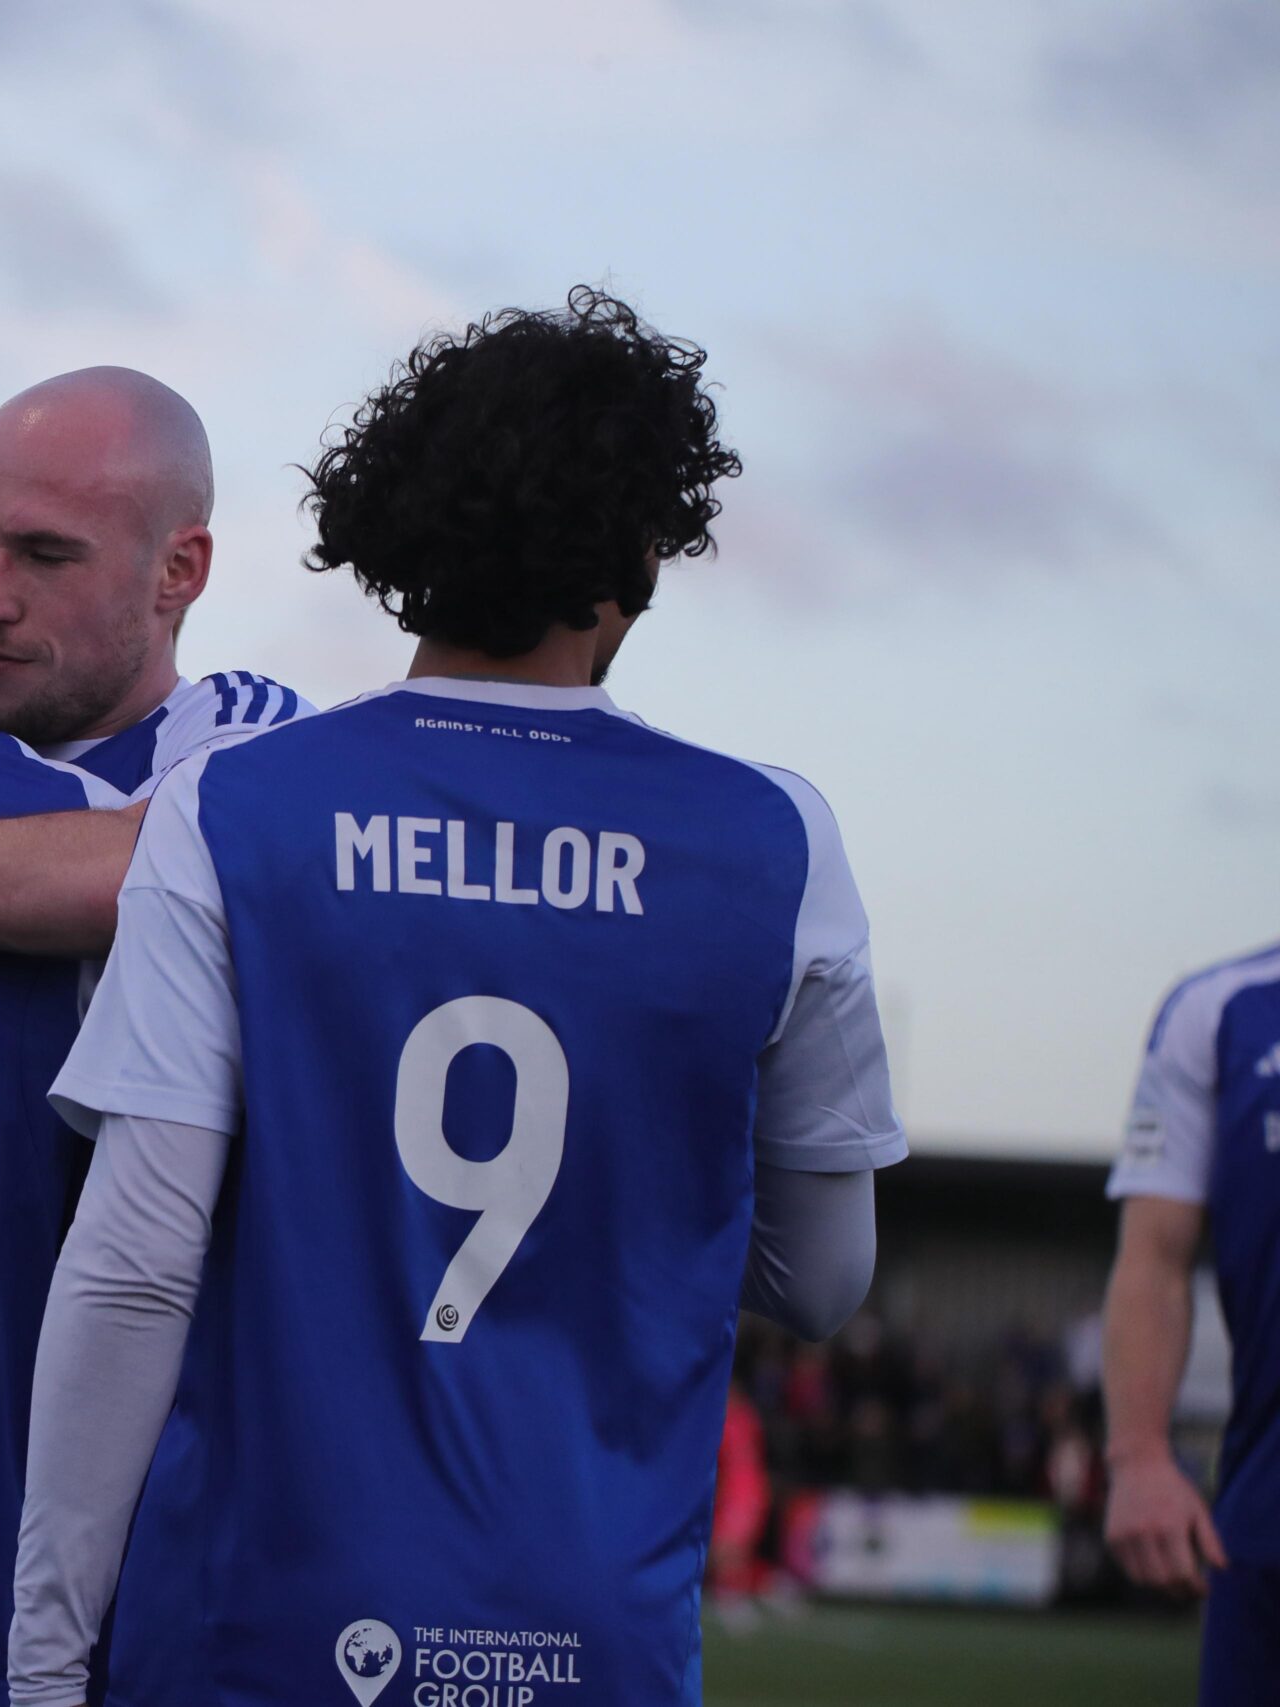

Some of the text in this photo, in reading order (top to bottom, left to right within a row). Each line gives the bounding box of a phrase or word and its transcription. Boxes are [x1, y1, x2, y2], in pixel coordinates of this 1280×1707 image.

[415, 718, 572, 743] AGAINST ALL ODDS
[334, 811, 646, 916] MELLOR
[394, 995, 570, 1344] 9
[414, 1627, 581, 1647] THE INTERNATIONAL
[415, 1649, 581, 1683] FOOTBALL
[413, 1682, 534, 1707] GROUP
